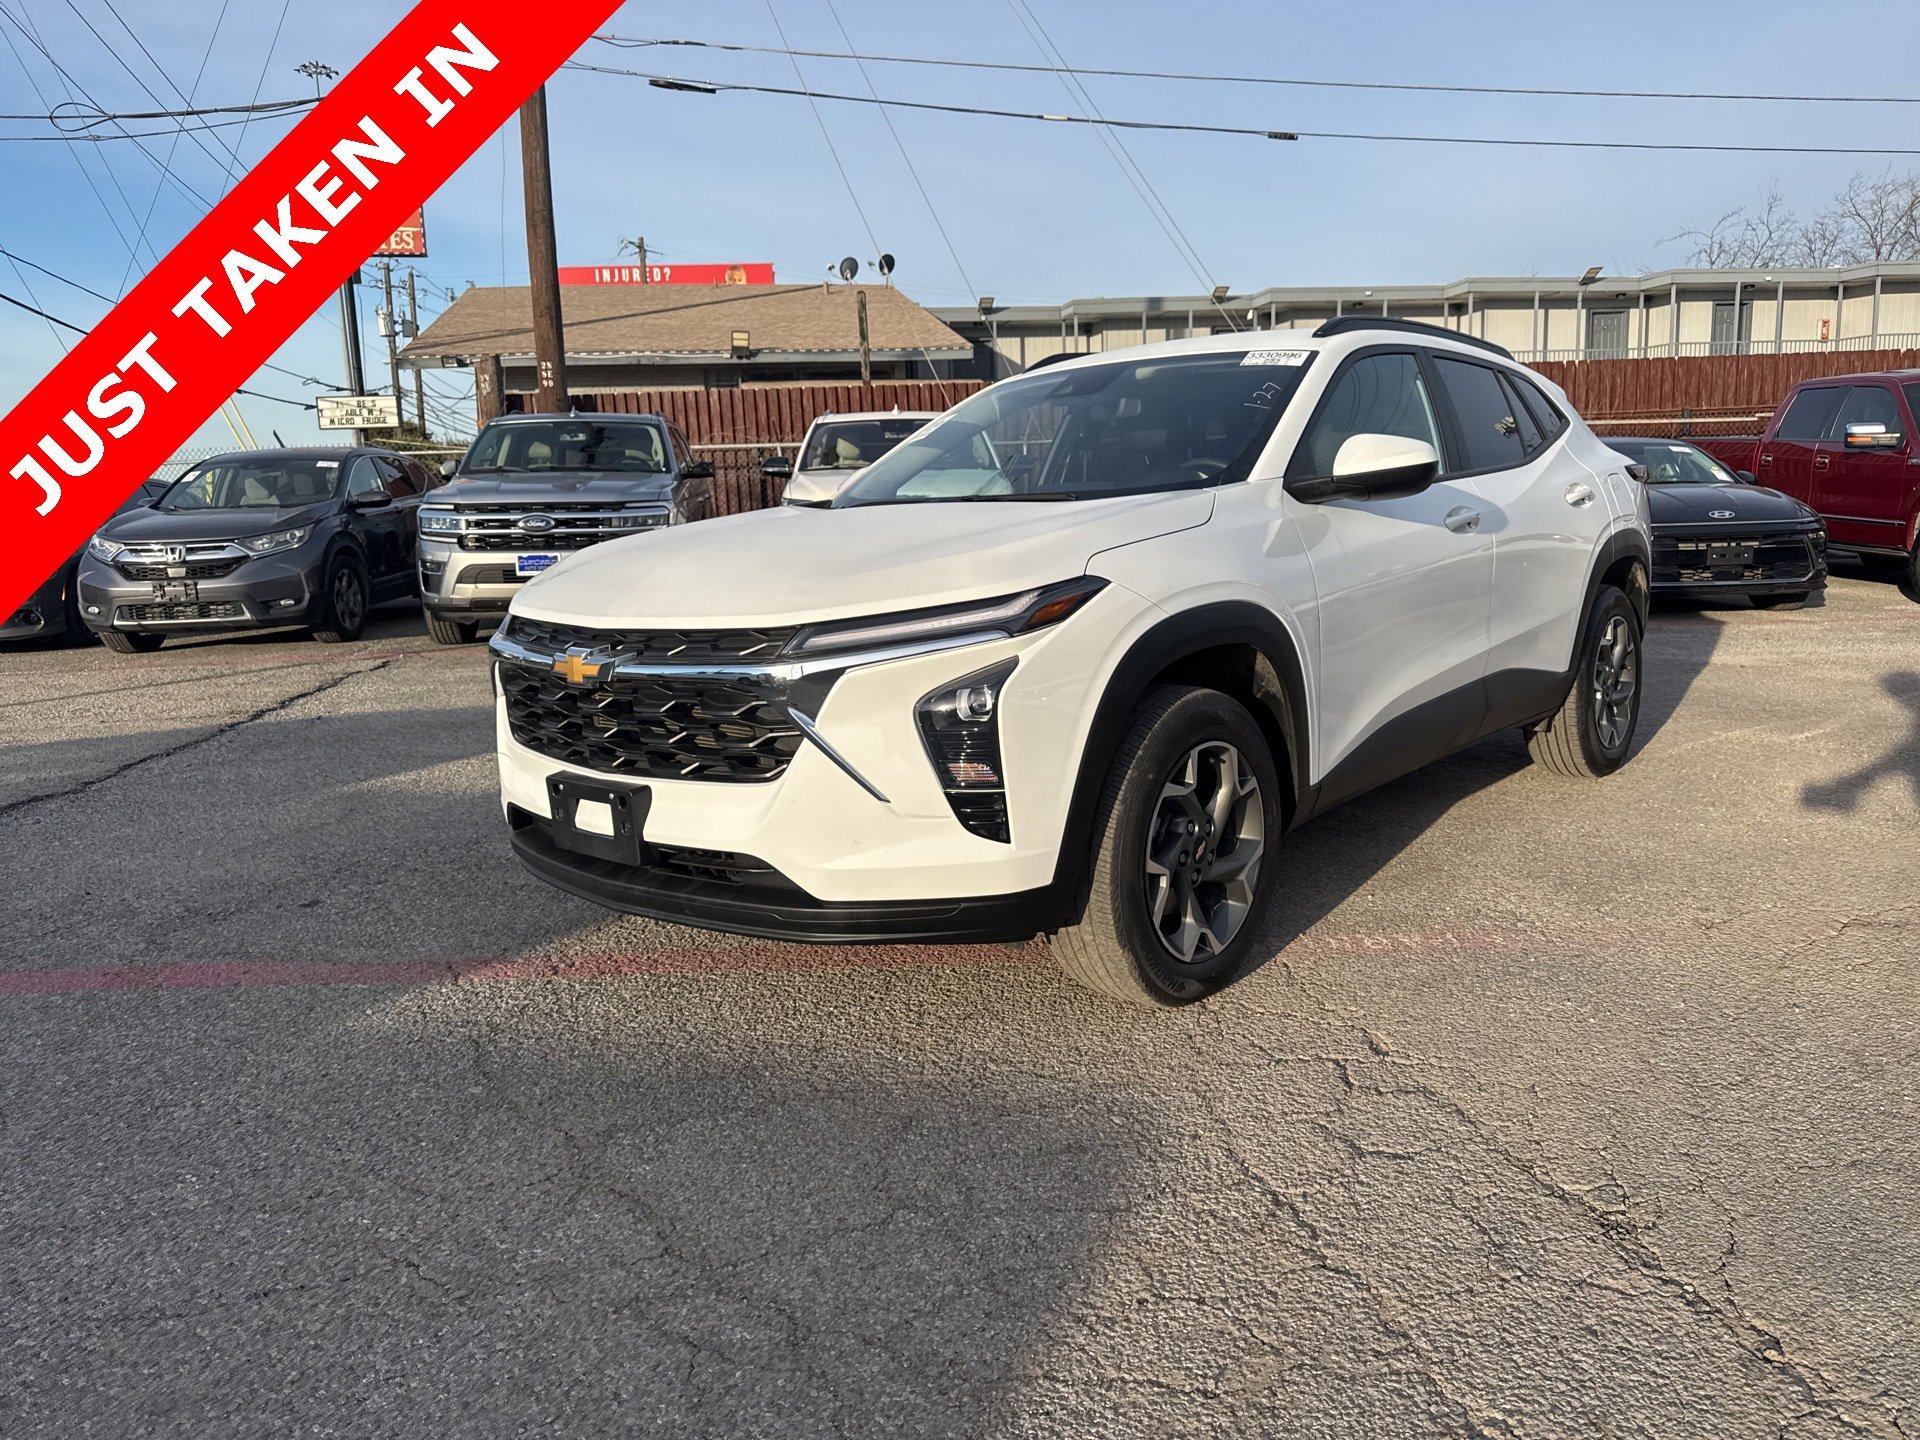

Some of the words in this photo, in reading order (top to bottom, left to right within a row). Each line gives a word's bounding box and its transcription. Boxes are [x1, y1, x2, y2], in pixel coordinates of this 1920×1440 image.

[380, 231, 415, 250] ES
[329, 417, 355, 426] MICRO
[361, 416, 388, 425] FRIDGE
